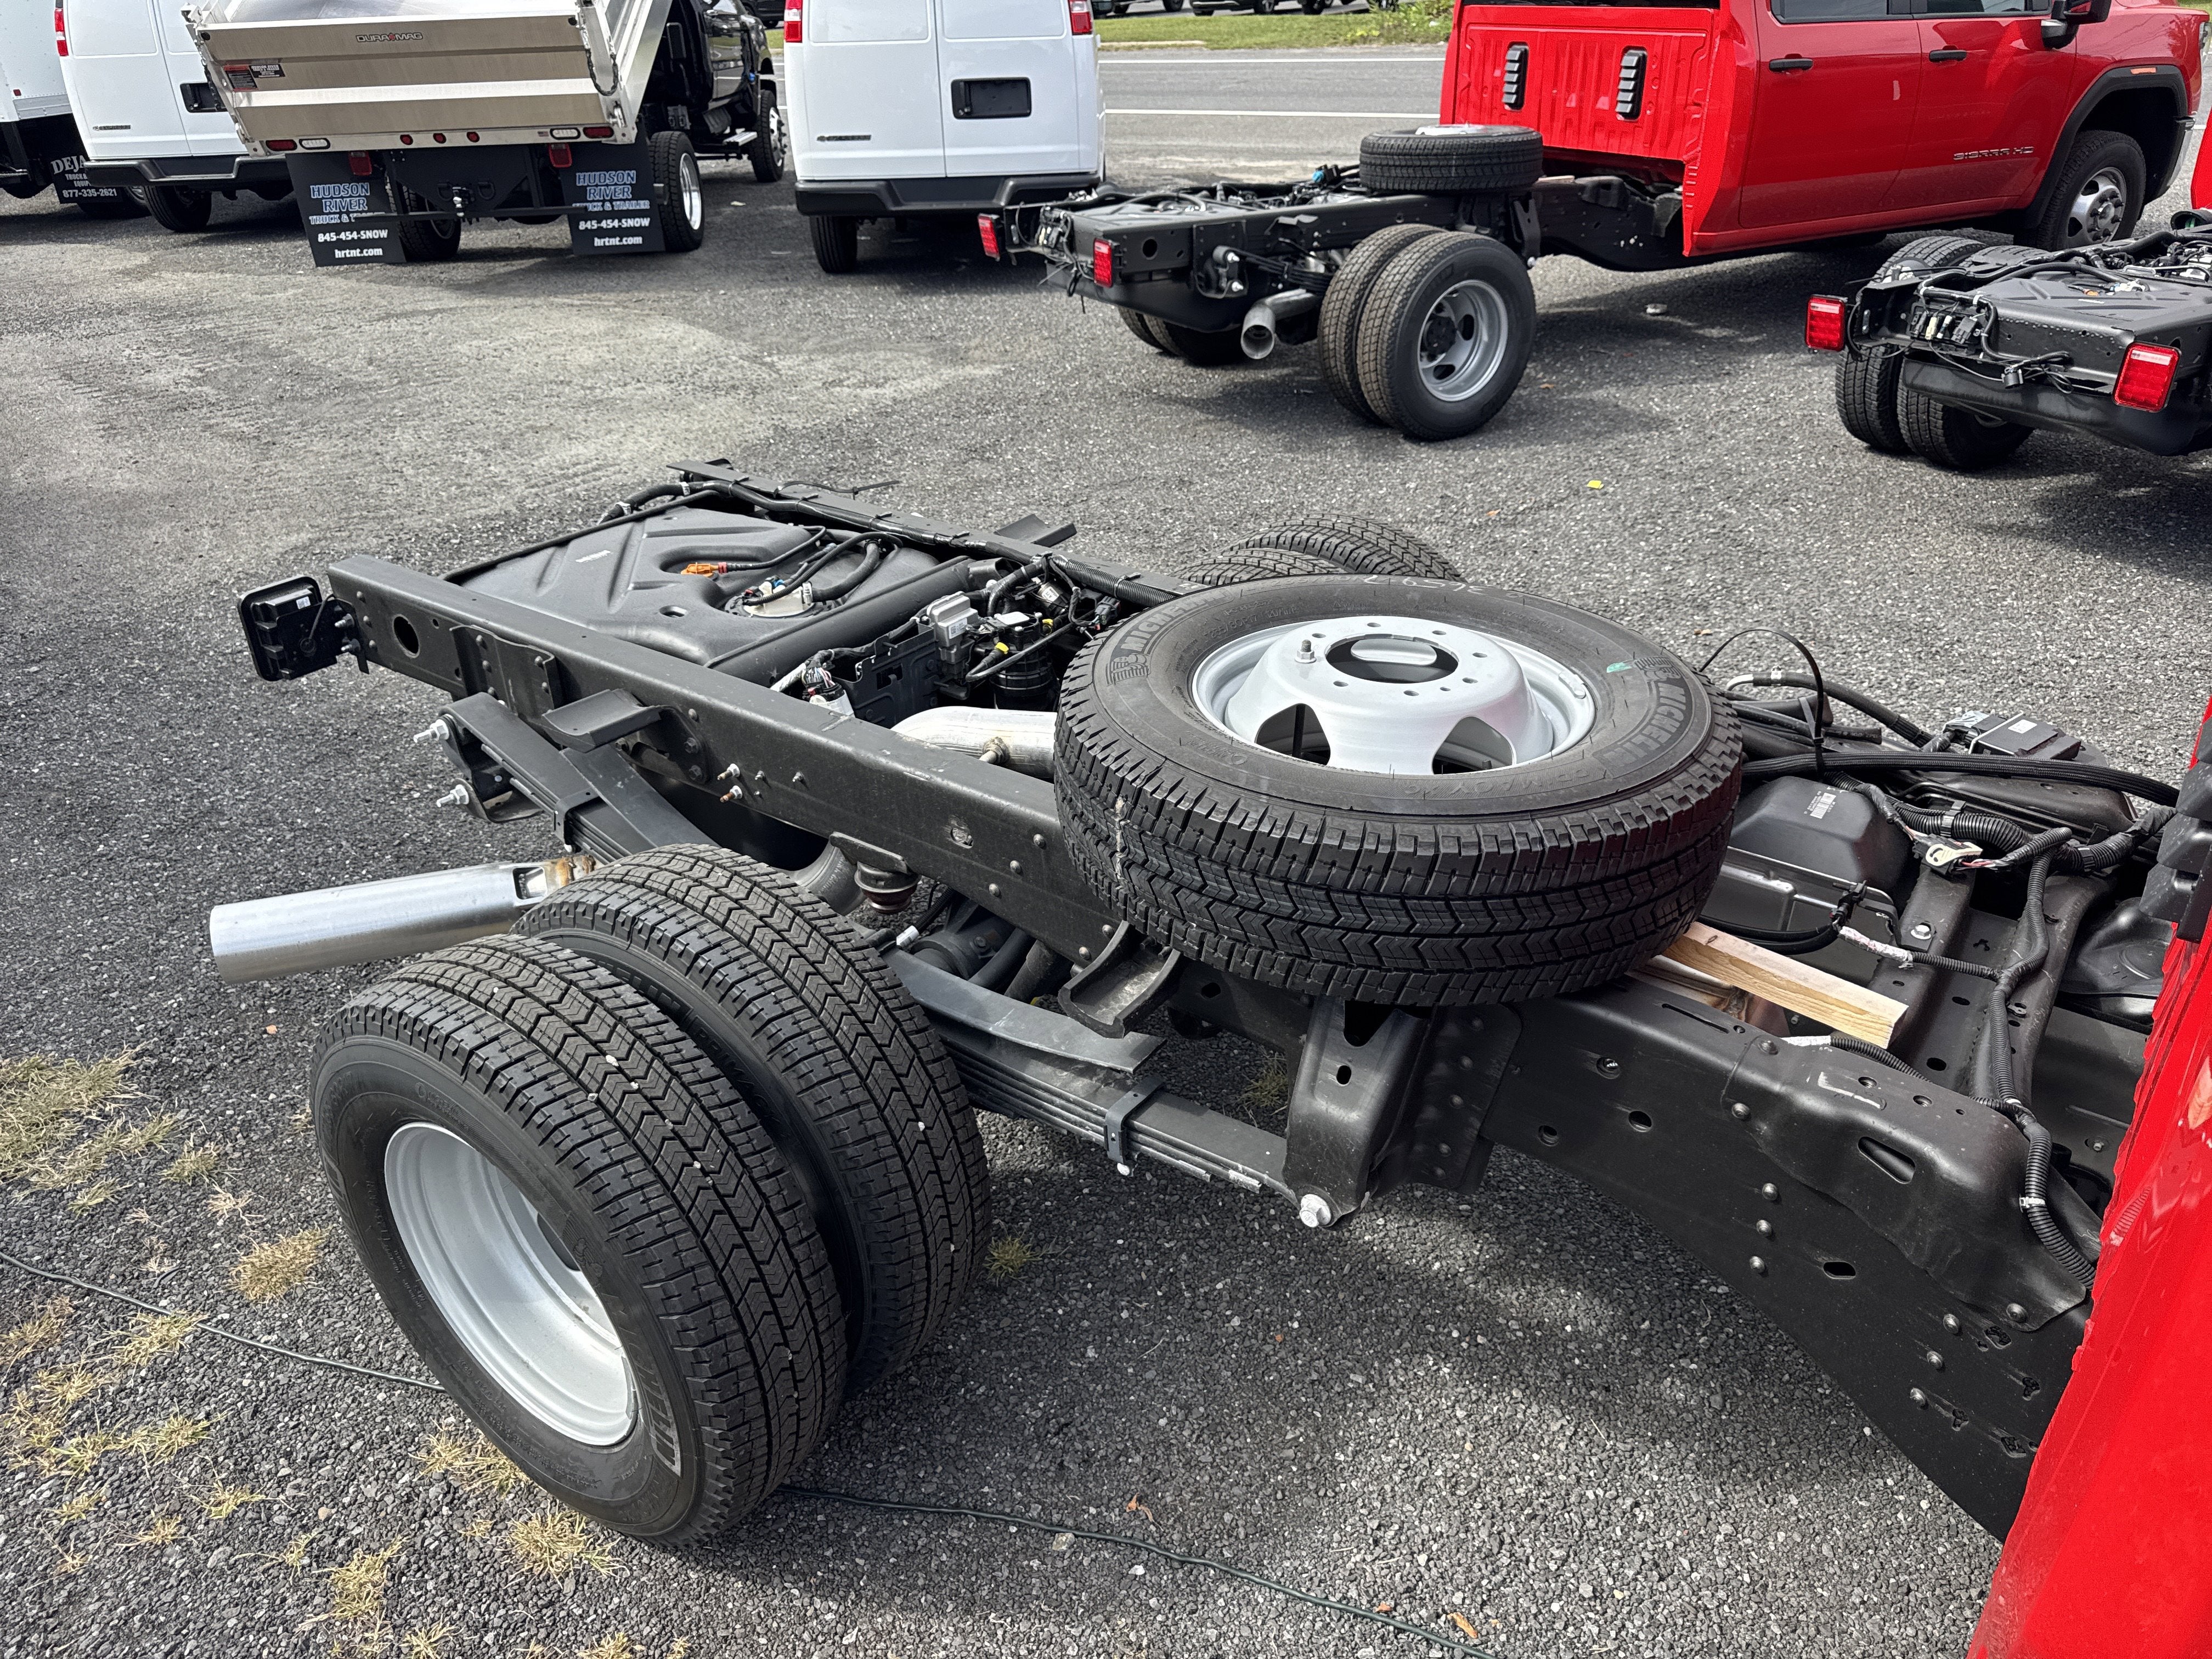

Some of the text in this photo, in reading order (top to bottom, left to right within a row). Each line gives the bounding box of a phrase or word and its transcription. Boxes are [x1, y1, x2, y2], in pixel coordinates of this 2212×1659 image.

[1954, 146, 2035, 161] SIERRA HD
[575, 170, 636, 186] HUDSON
[62, 188, 117, 198] 877-335-2621
[310, 182, 370, 198] HUDSON
[586, 185, 632, 200] RIVER
[322, 197, 368, 212] RIVER
[604, 201, 612, 211] &
[309, 214, 340, 224] TRUCK
[341, 214, 349, 222] &
[579, 217, 650, 230] 845-454-SNOW
[318, 229, 388, 242] 845-454-SNOW
[594, 236, 642, 246] hrtnt.com
[335, 248, 383, 258] hrtnt.com
[1120, 590, 1226, 652] MICHELIN
[1602, 682, 1686, 766] MICHELIN
